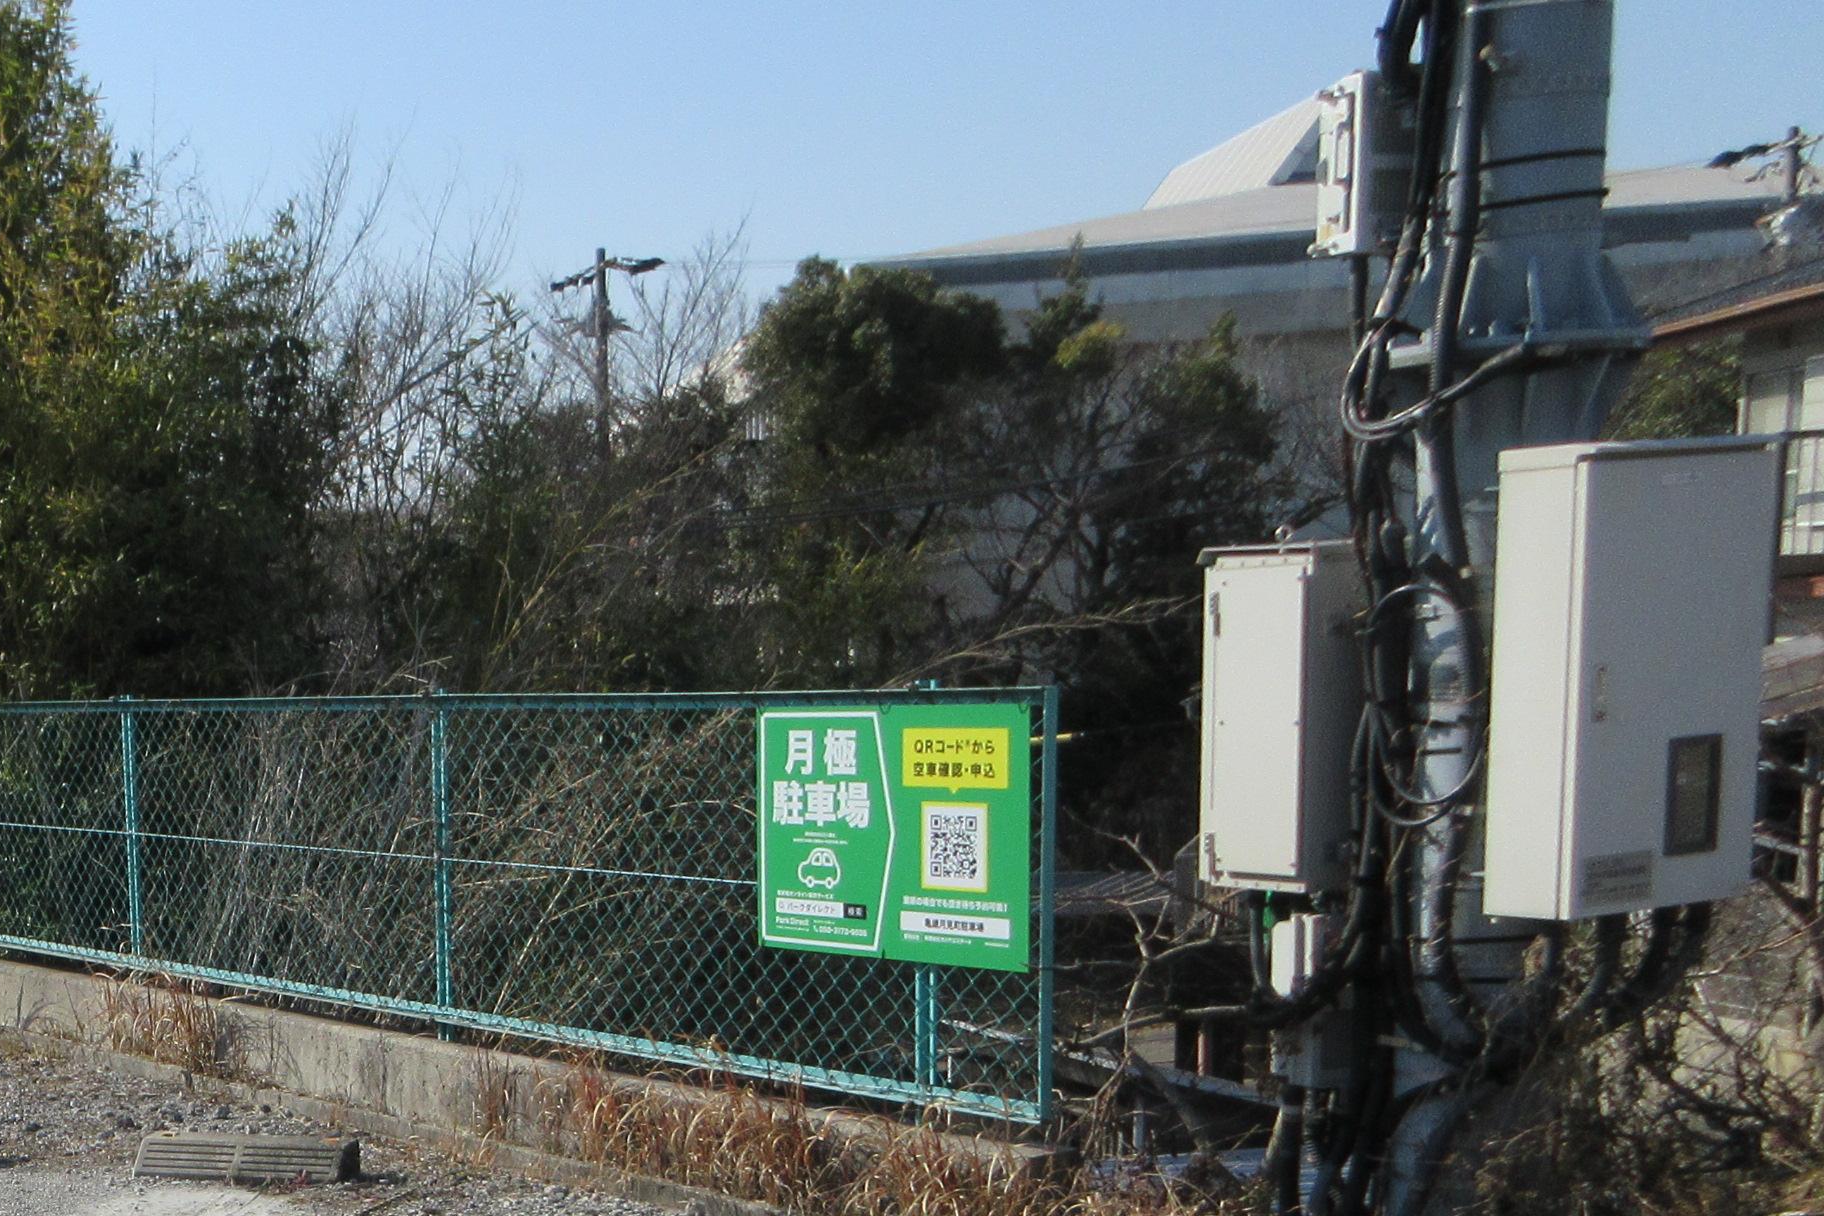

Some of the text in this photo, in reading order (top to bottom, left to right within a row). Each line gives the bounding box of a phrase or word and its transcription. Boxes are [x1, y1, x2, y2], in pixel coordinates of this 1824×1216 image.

[784, 728, 857, 776] 月極
[913, 761, 996, 779] 空車確認・申込
[772, 780, 870, 828] 駐車場
